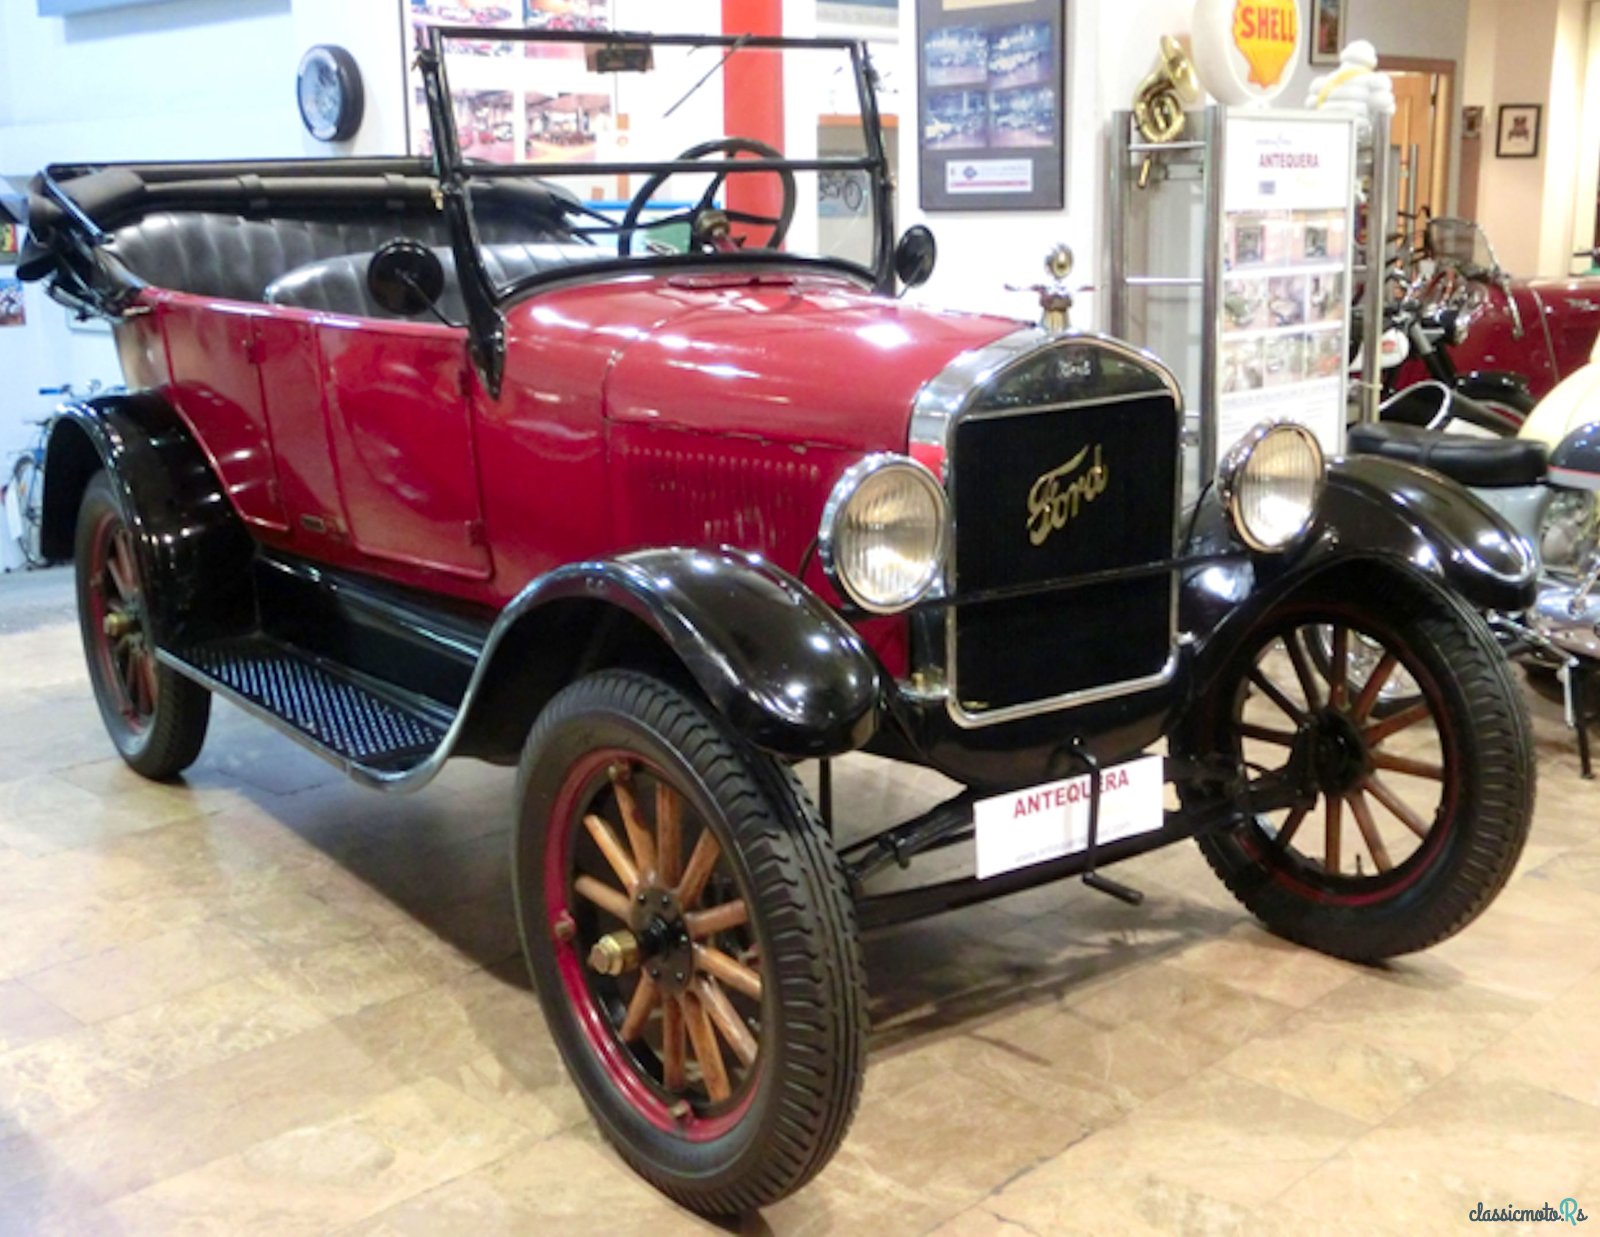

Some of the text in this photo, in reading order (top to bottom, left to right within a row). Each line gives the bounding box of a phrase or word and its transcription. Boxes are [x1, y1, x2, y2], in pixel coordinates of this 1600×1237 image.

[1241, 6, 1295, 43] SHELL
[1258, 152, 1320, 168] ANTEQUERA
[1026, 443, 1109, 546] Ford
